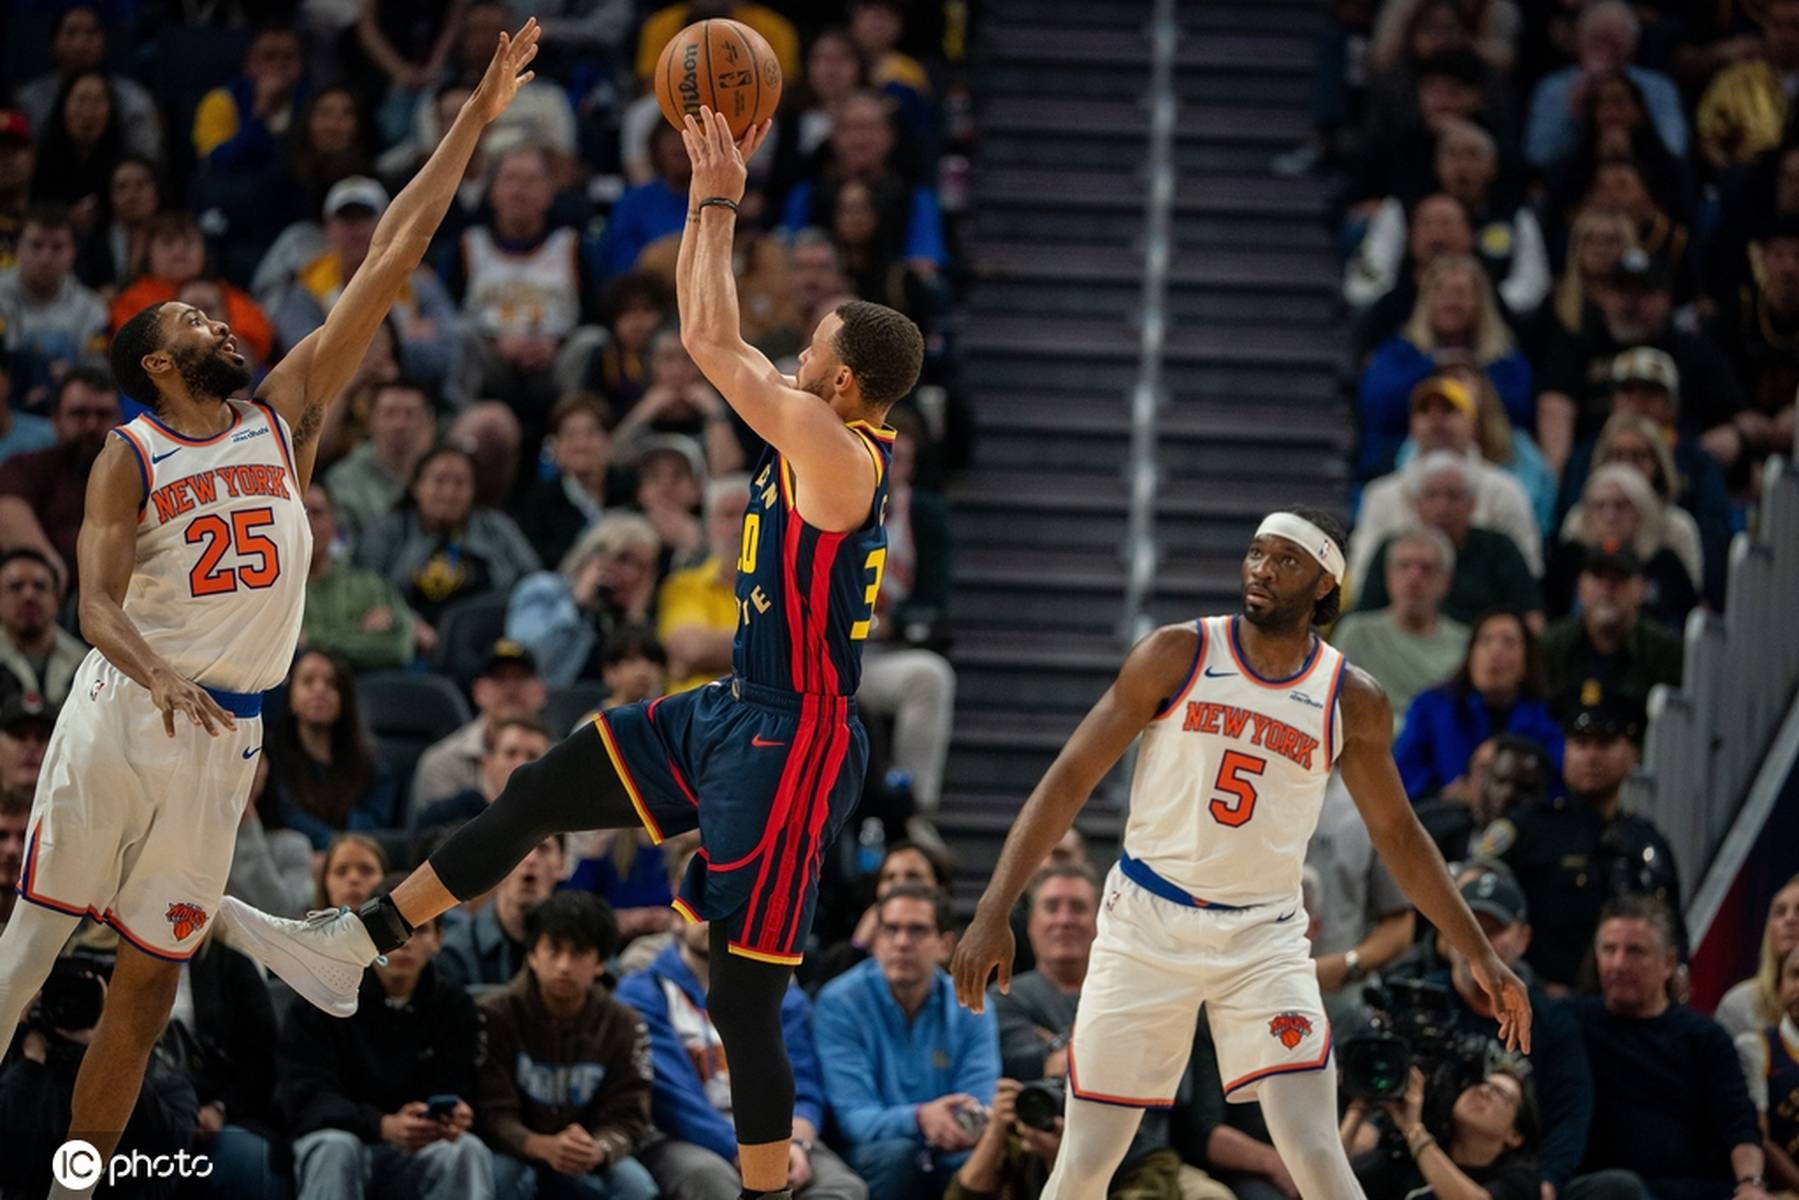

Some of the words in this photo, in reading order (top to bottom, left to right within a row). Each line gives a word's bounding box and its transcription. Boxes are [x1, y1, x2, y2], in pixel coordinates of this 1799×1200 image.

[151, 470, 218, 525] NEW
[214, 463, 291, 501] YORK
[183, 506, 281, 598] 25
[738, 512, 760, 574] 0
[1182, 701, 1251, 739] NEW
[1250, 712, 1319, 770] YORK
[1208, 748, 1267, 828] 5
